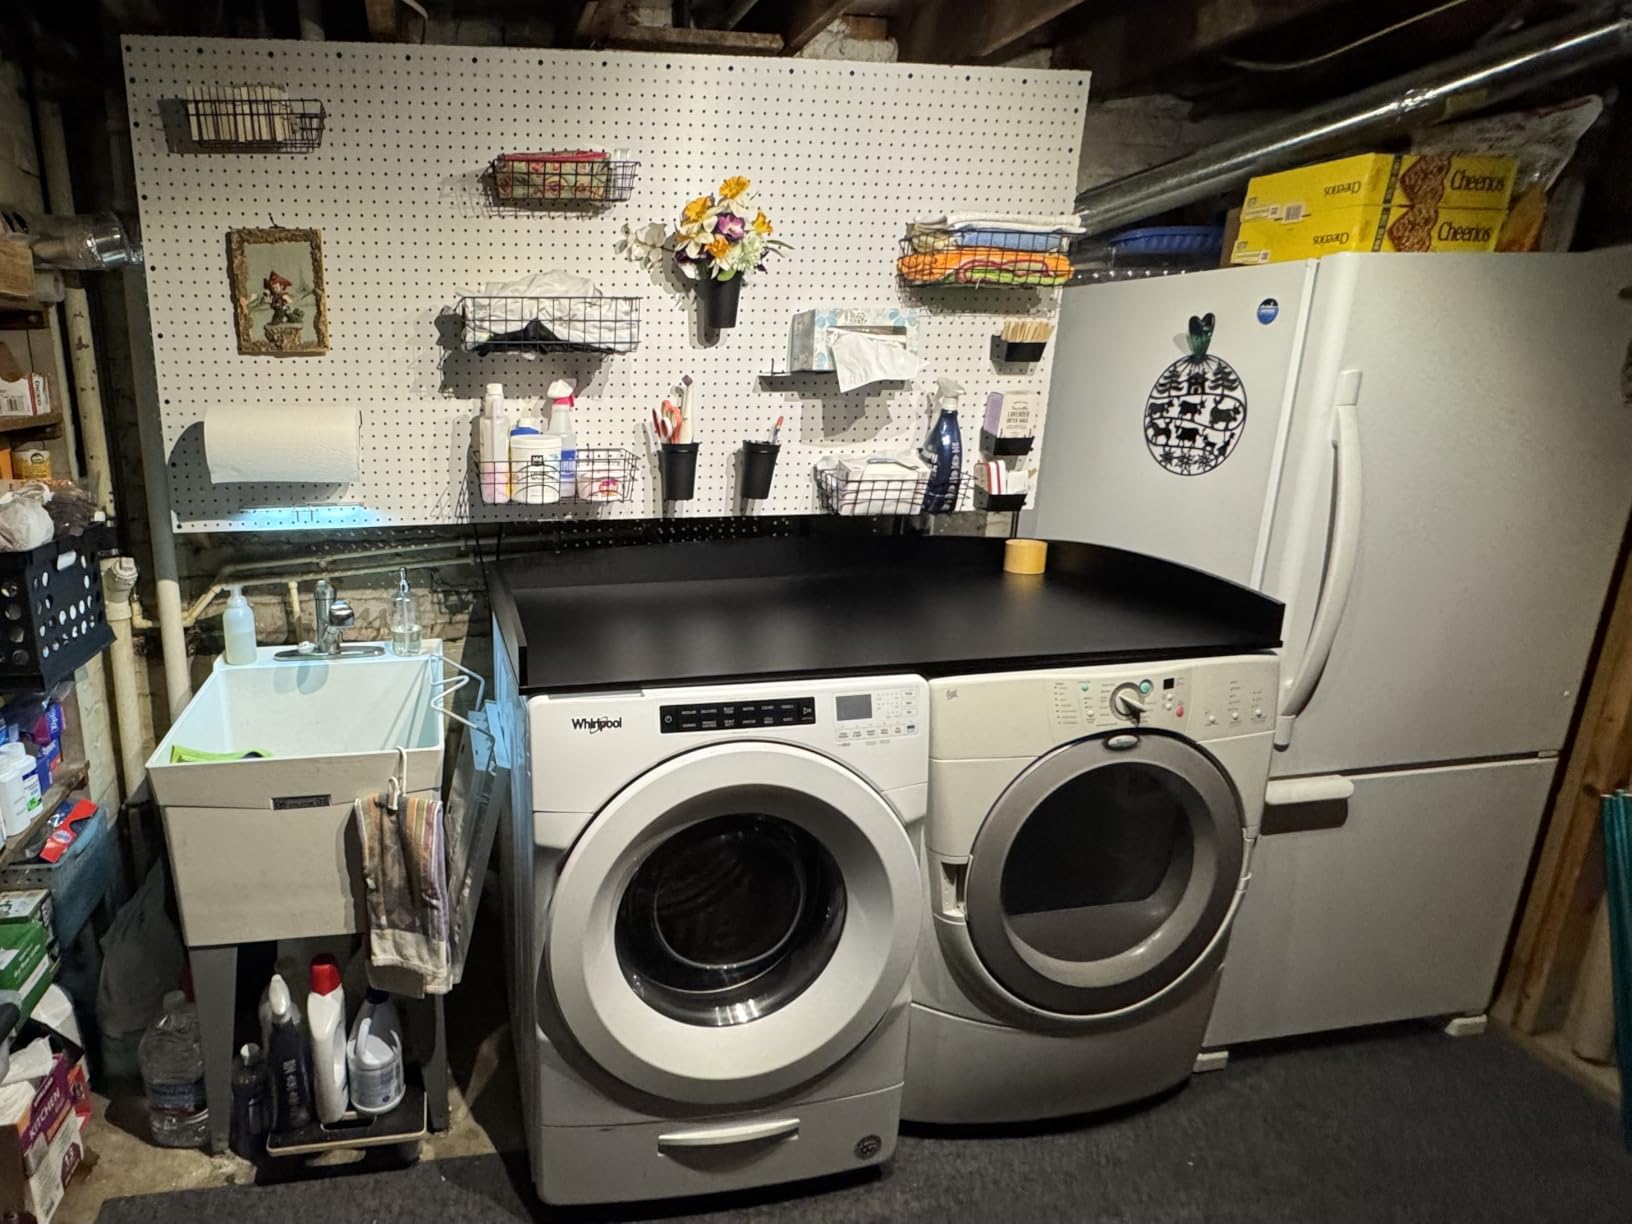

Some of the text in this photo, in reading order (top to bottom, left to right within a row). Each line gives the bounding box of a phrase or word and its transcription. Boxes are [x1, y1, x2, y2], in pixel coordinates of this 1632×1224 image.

[1324, 181, 1361, 196] Cheerios
[1451, 169, 1505, 192] Cheerios
[1312, 231, 1349, 245] Cheerios
[1438, 222, 1492, 243] Cheerios
[571, 715, 622, 734] Whirlpool
[29, 1087, 60, 1139] KITCHEN
